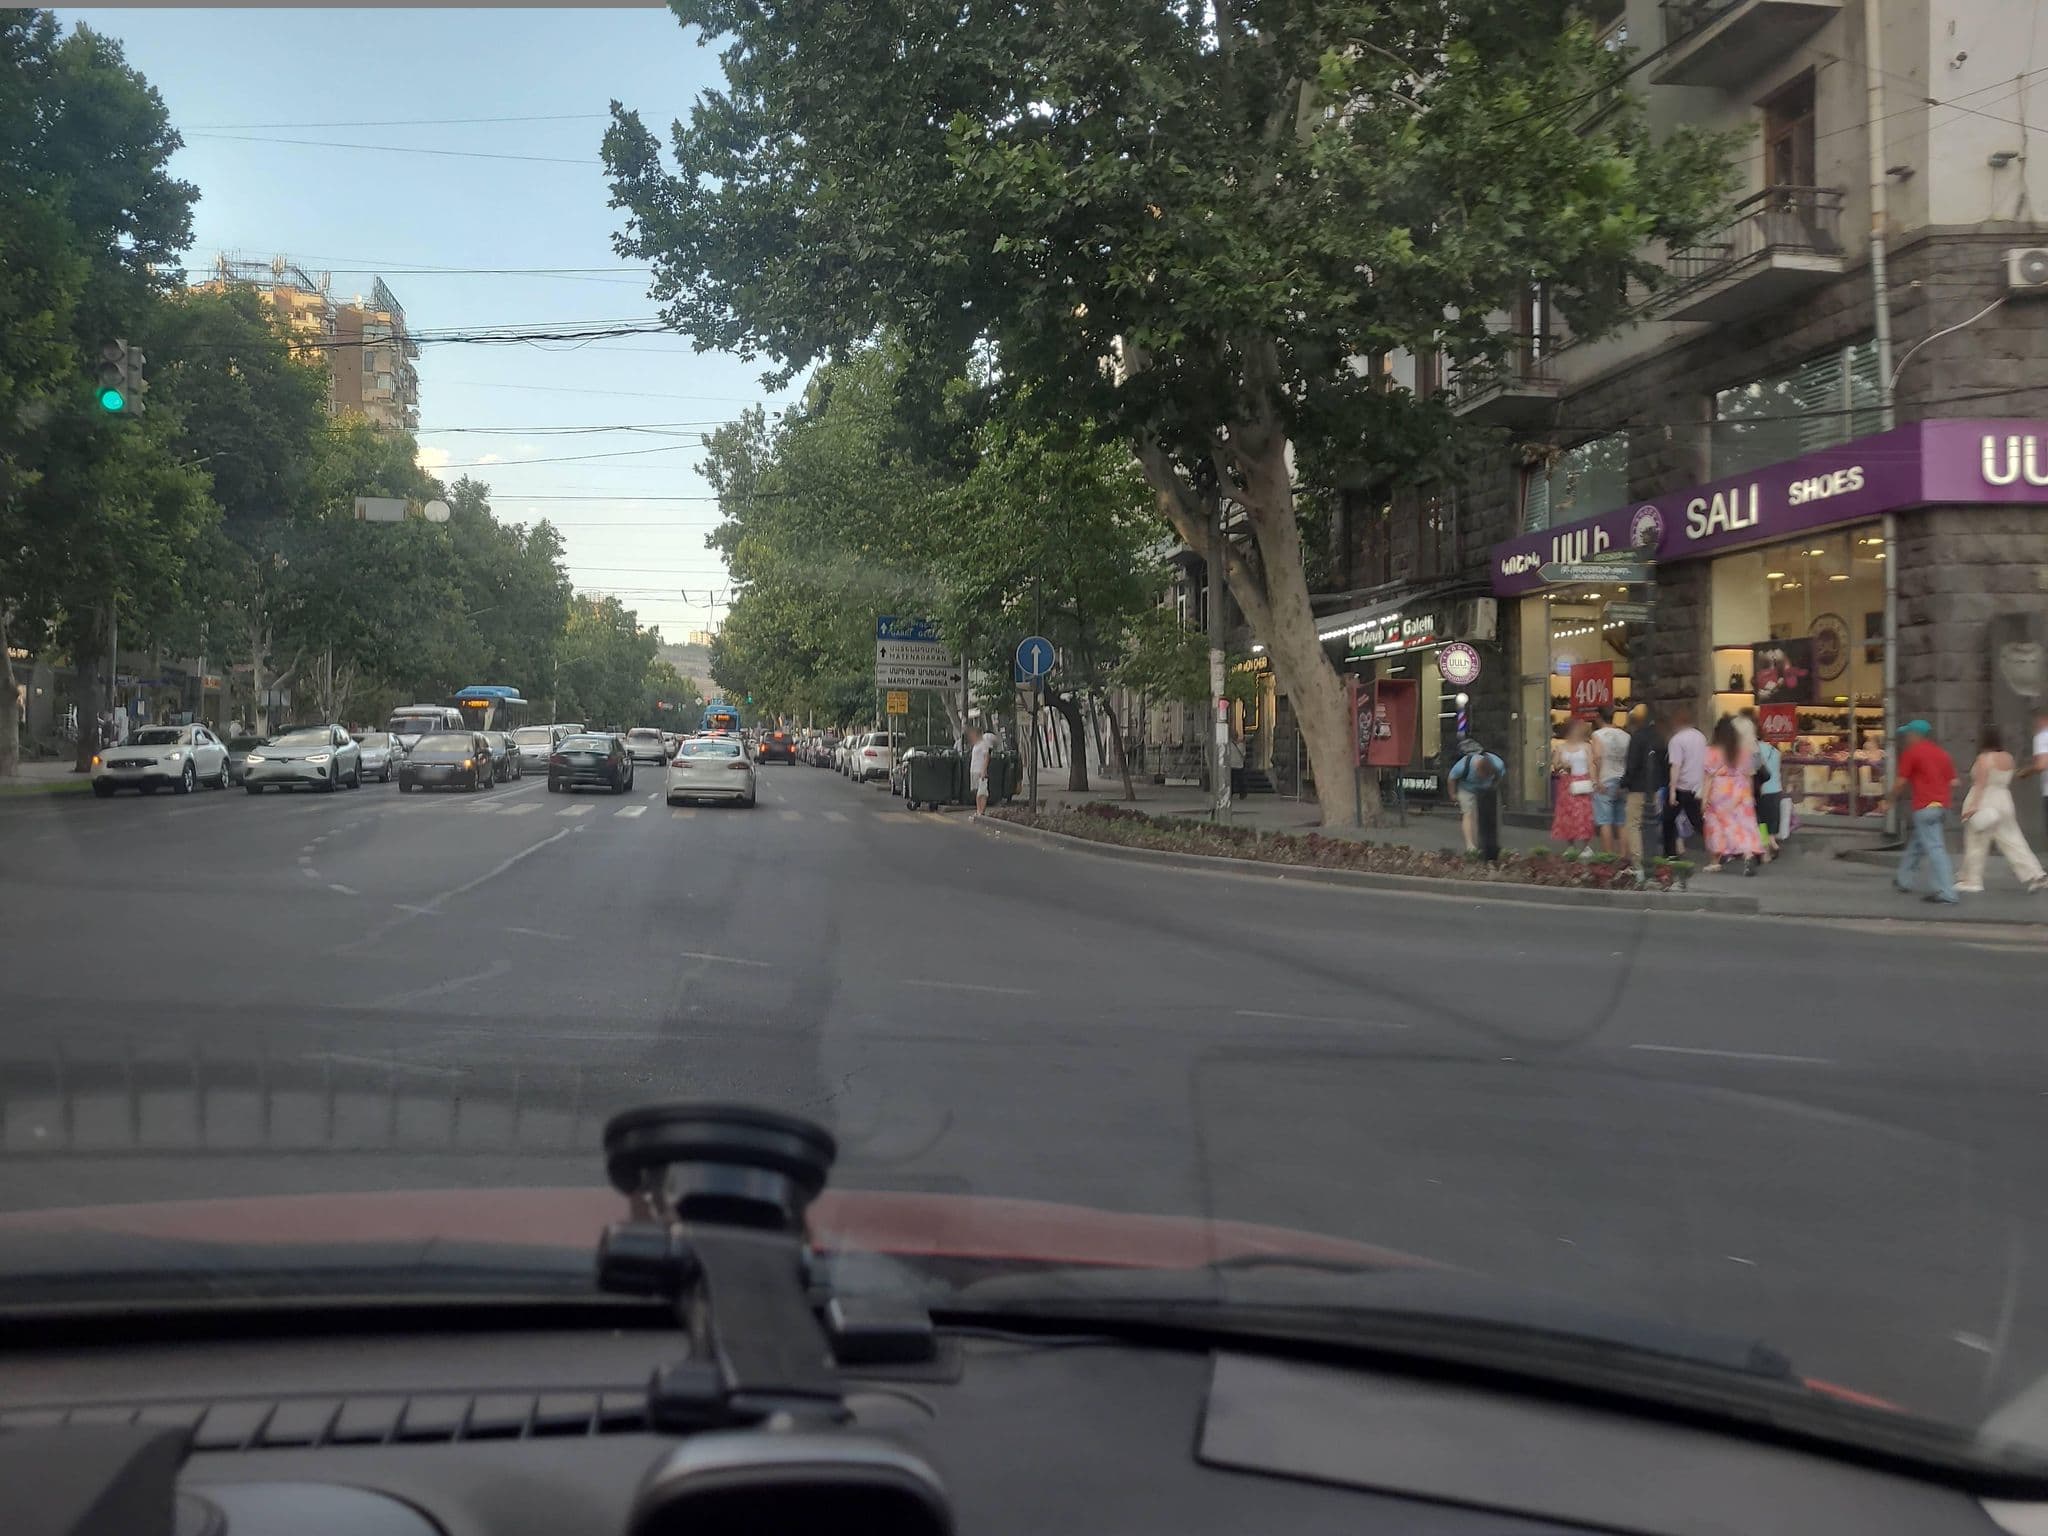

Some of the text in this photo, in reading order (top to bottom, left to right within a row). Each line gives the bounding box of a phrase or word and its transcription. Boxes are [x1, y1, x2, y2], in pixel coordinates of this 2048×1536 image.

[1686, 466, 1865, 540] SALI SHOES
[1403, 614, 1434, 634] Galetti
[920, 678, 948, 687] ARMENIA
[1575, 678, 1608, 704] 40%
[1763, 715, 1792, 733] 40%
